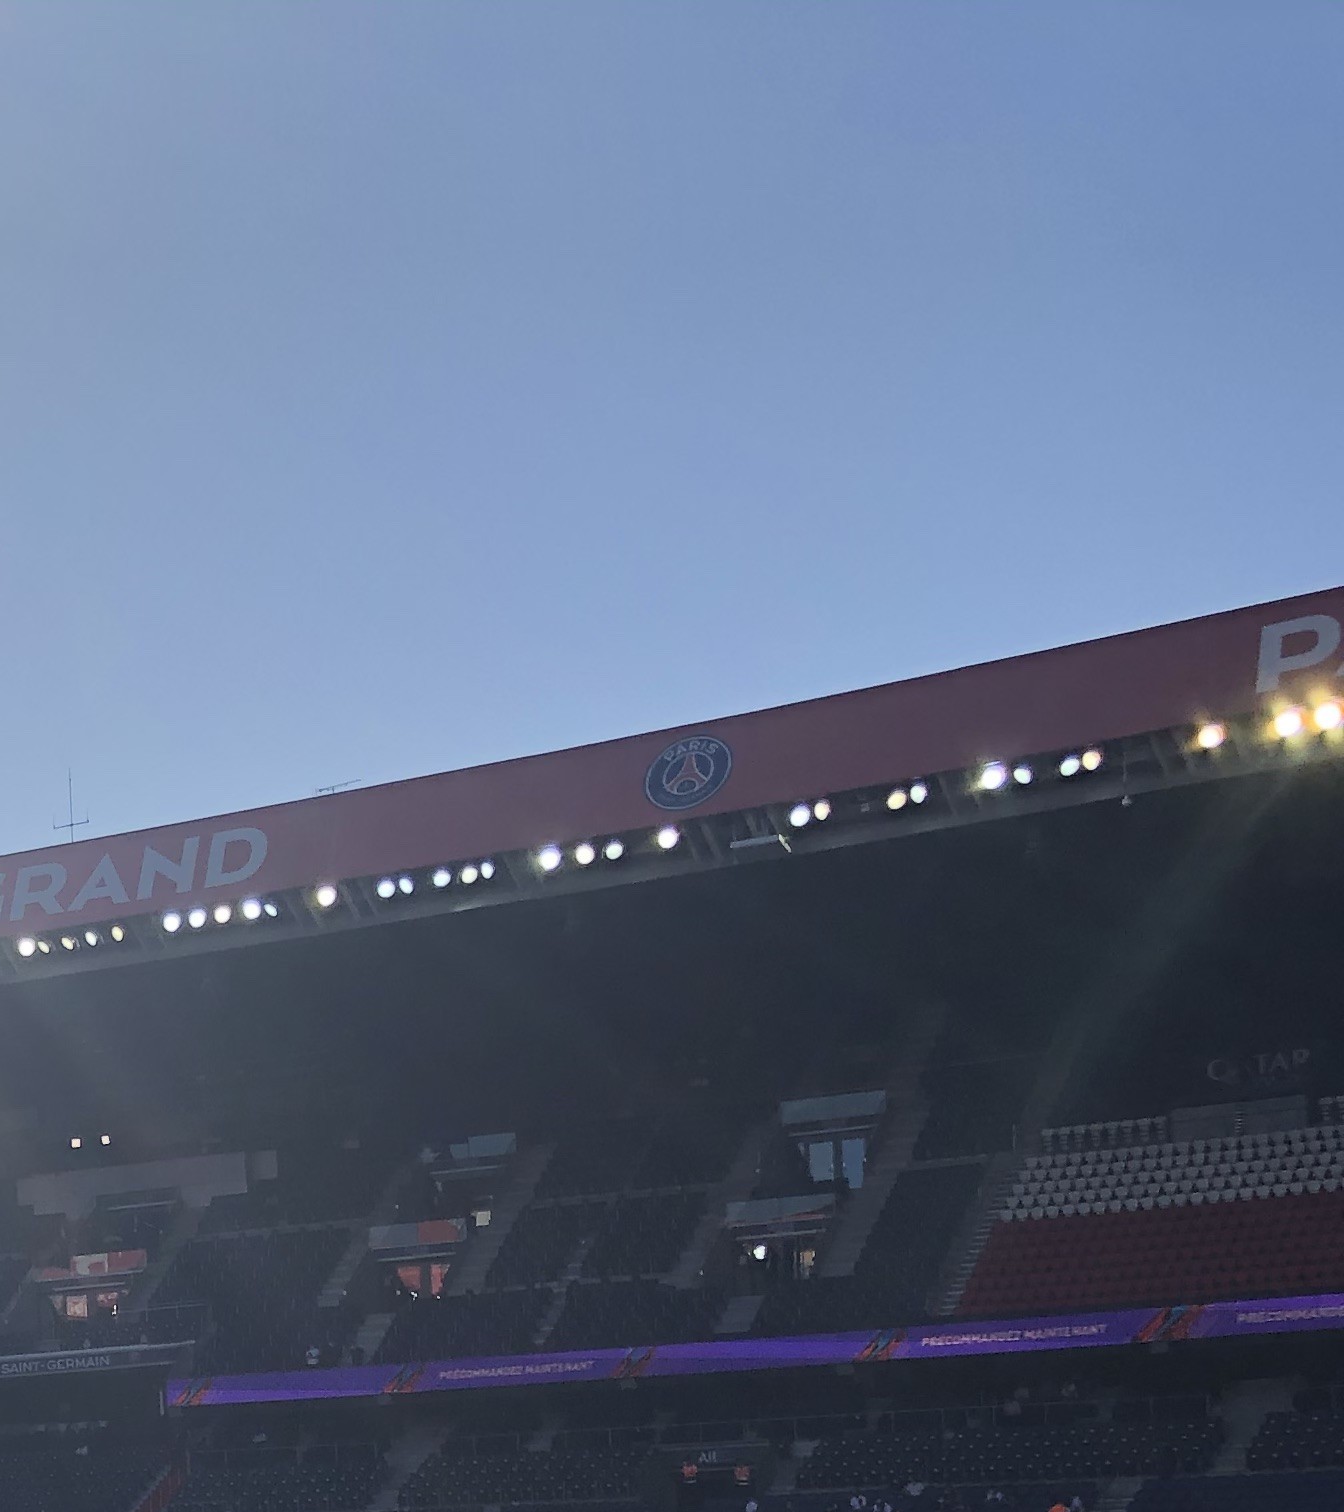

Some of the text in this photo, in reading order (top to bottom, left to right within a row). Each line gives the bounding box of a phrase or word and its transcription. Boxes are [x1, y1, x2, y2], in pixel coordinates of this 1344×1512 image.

[1256, 615, 1344, 694] P
[664, 741, 719, 761] PARIS
[0, 1355, 111, 1375] SAINT-GERMAIN
